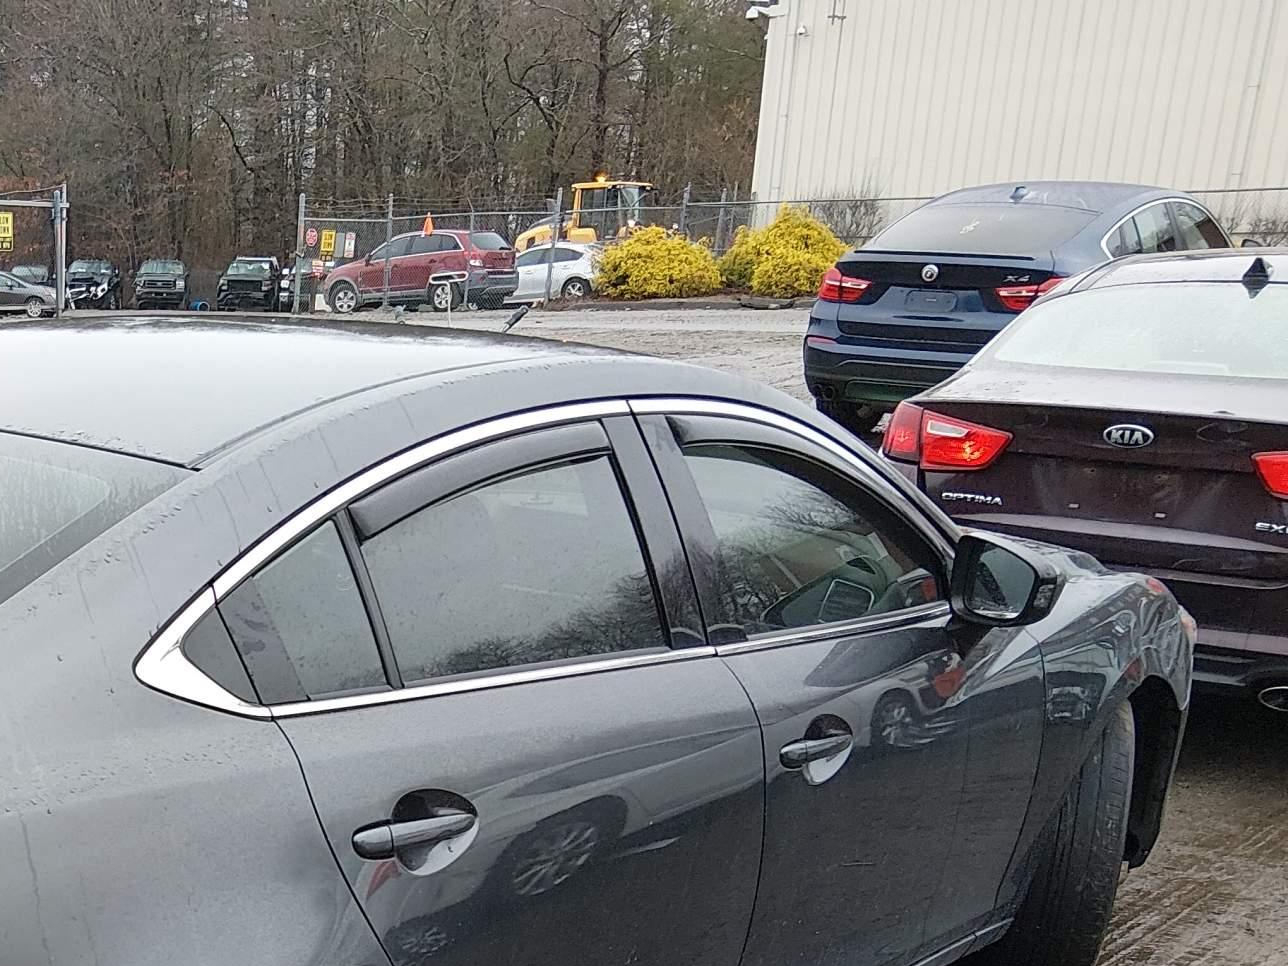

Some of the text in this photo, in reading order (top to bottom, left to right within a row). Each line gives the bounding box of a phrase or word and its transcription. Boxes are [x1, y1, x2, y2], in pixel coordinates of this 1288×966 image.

[1002, 274, 1032, 282] X4
[1110, 429, 1145, 445] KIA
[941, 492, 1003, 506] OPTIMA
